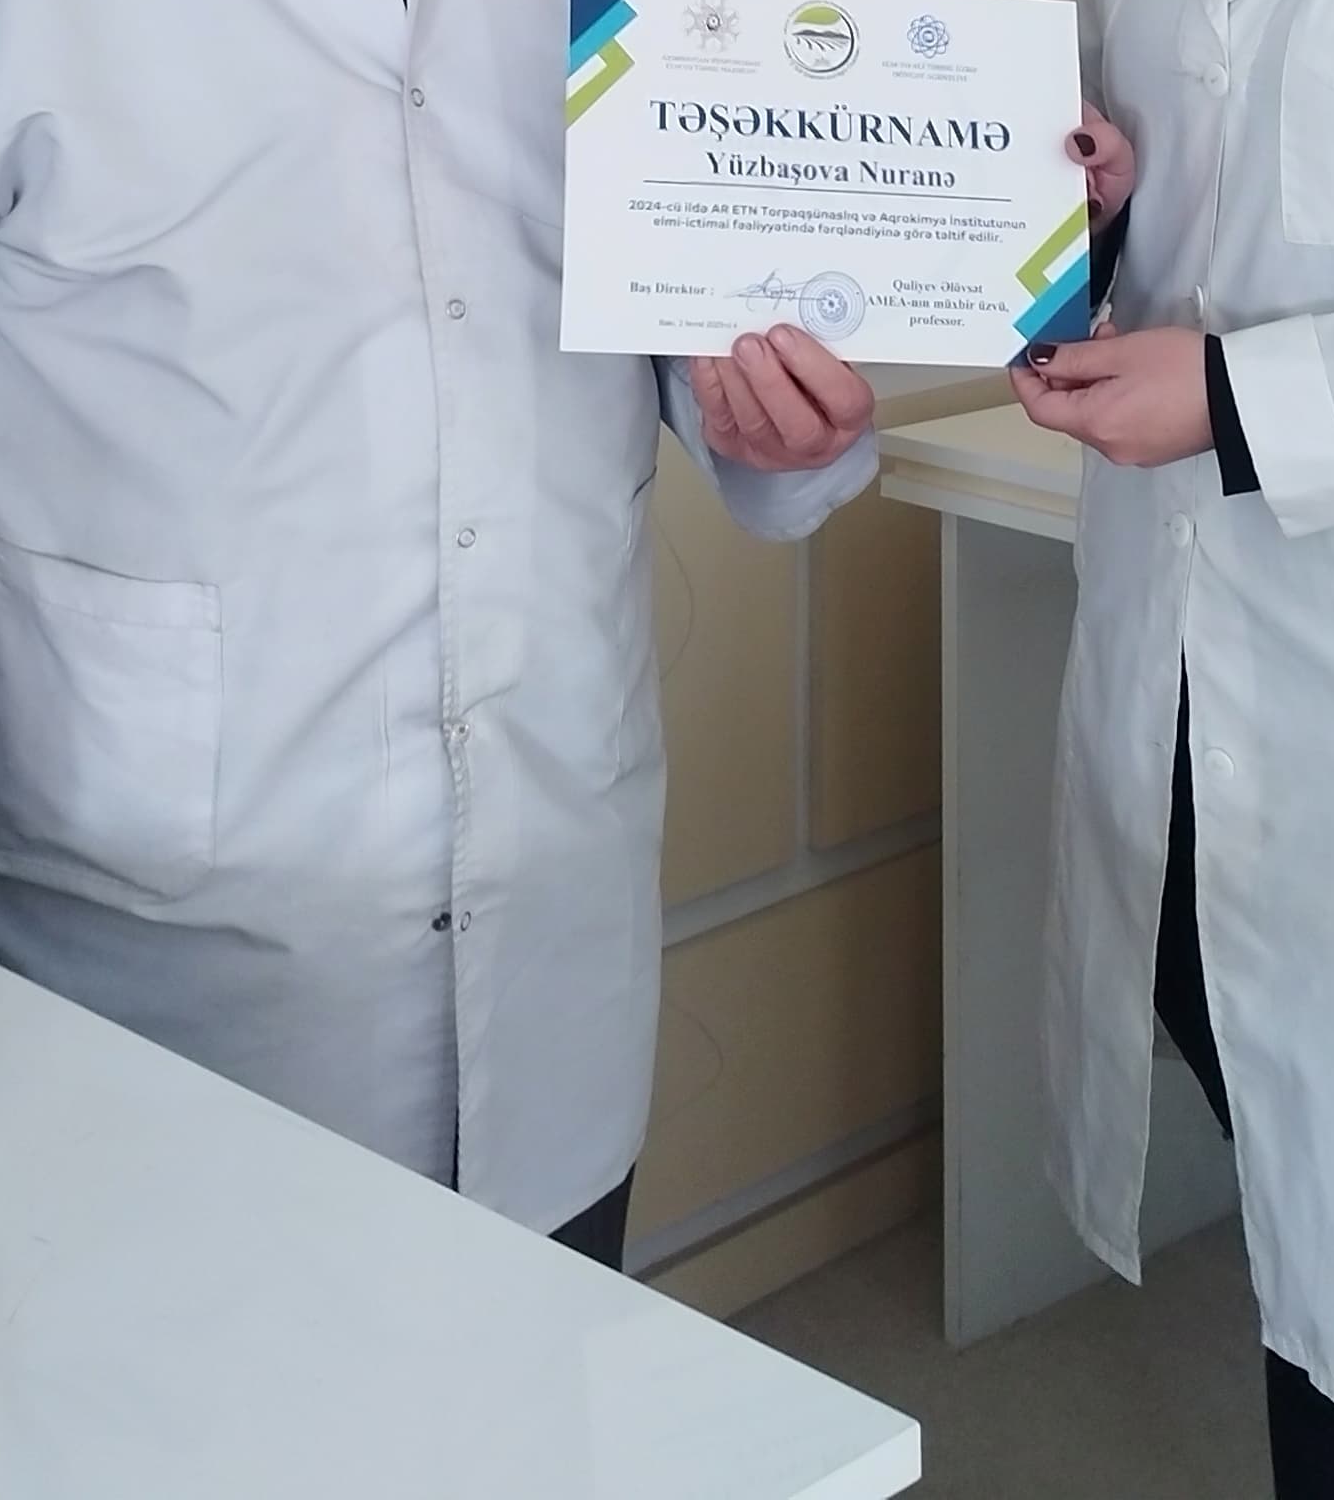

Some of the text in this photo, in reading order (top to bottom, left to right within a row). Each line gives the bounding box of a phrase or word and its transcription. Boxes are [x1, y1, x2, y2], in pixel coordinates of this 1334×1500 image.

[650, 99, 1011, 152] TƏŞƏKKÜRNAMƏ
[706, 151, 956, 188] Yüzbaşova Nuranə
[711, 204, 730, 214] AR
[732, 205, 758, 215] ETN
[861, 213, 876, 221] və
[653, 216, 730, 229] elmi-ictimai
[904, 228, 932, 241] görə
[630, 281, 651, 295] Baş
[655, 282, 707, 295] Direktor
